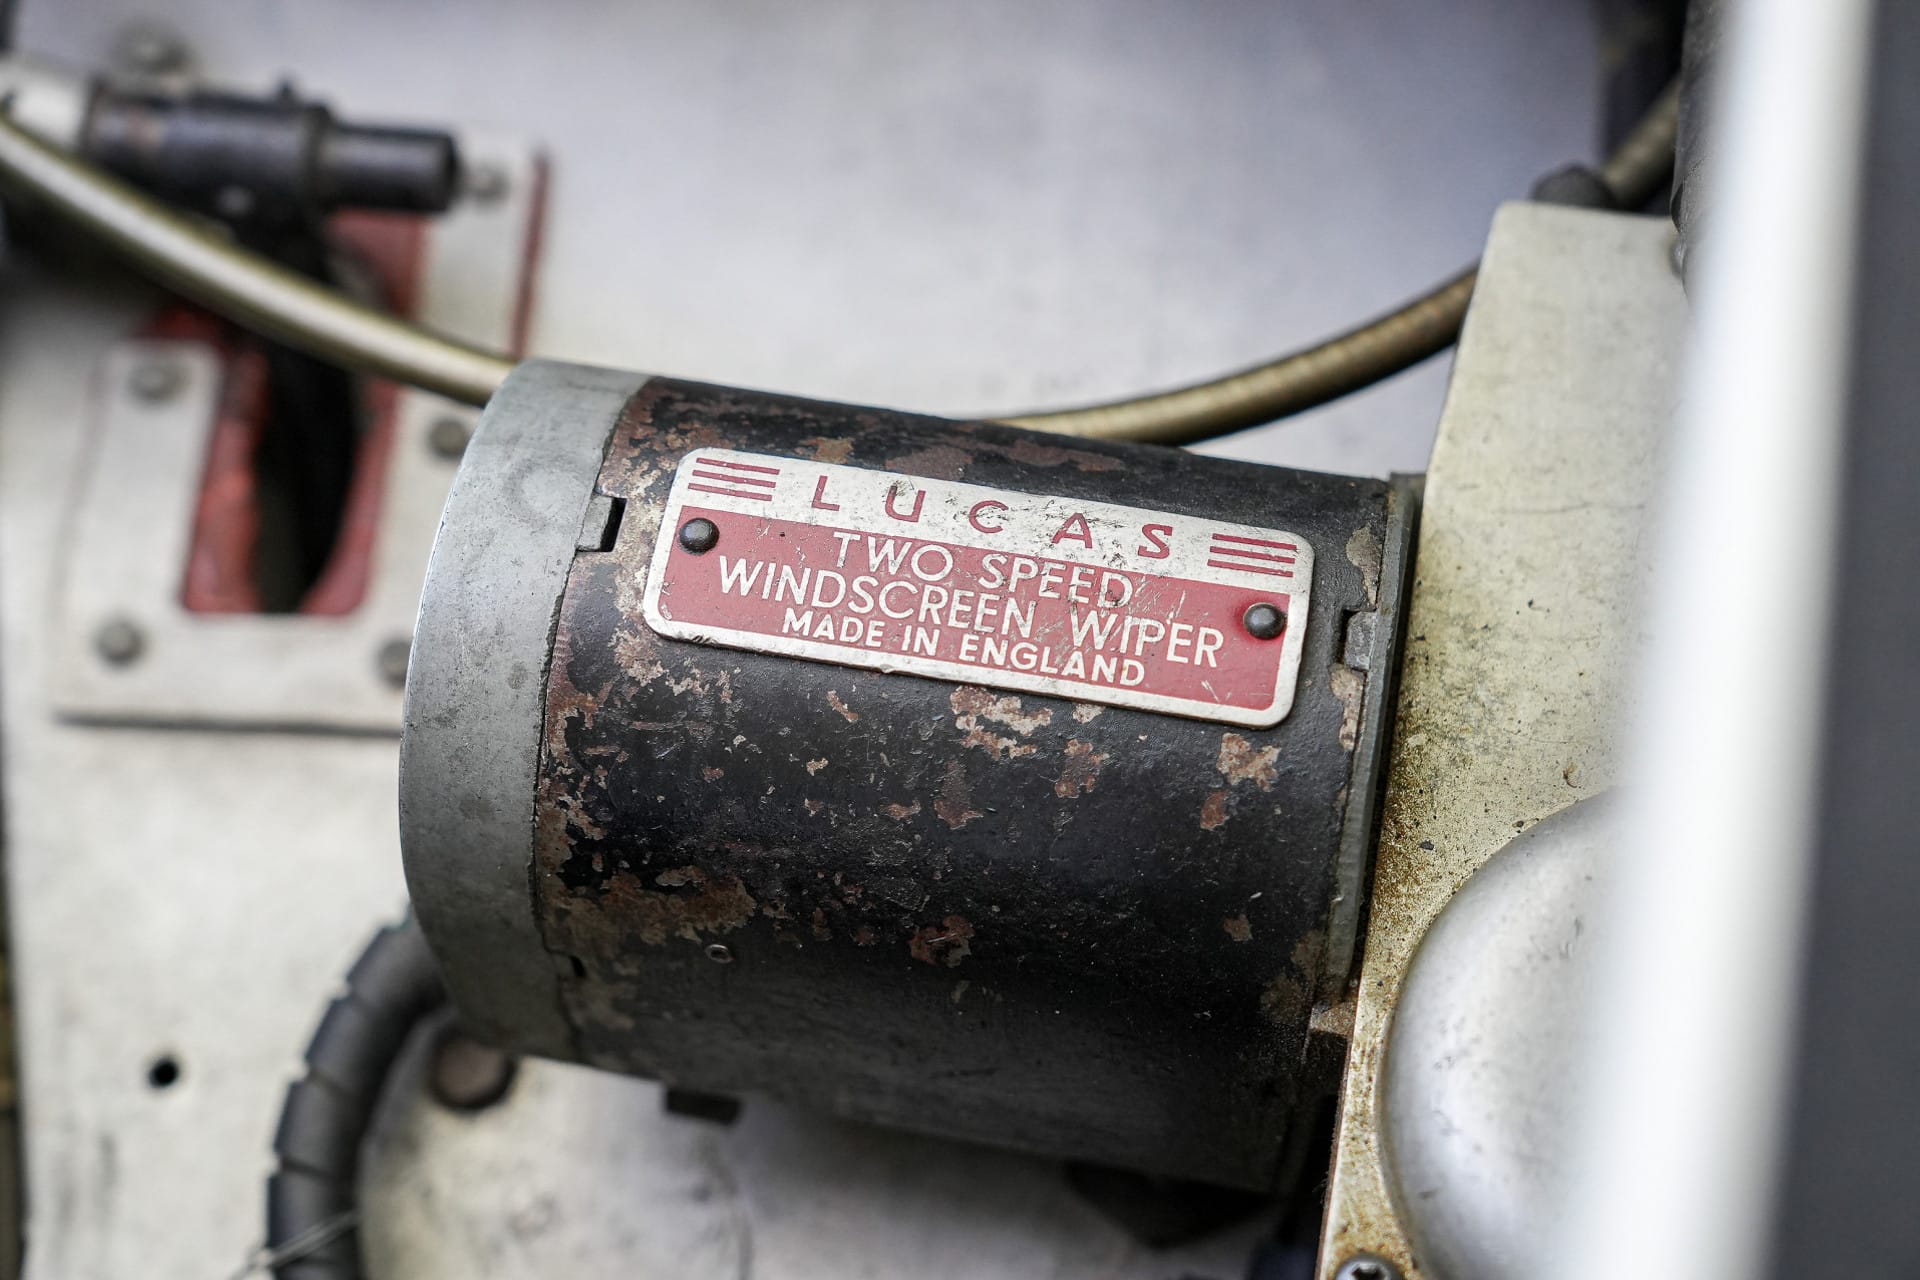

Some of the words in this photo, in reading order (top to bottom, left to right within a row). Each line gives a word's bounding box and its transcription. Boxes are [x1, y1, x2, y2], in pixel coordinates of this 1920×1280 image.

[811, 475, 1174, 560] LUCAS
[833, 532, 954, 582] TWO
[979, 552, 1133, 608] SPEED
[718, 556, 1036, 638] WINDSCREEN
[1070, 602, 1224, 668] WIPER
[782, 609, 883, 648] MADE
[902, 626, 938, 656] IN
[959, 635, 1146, 687] ENGLAND
